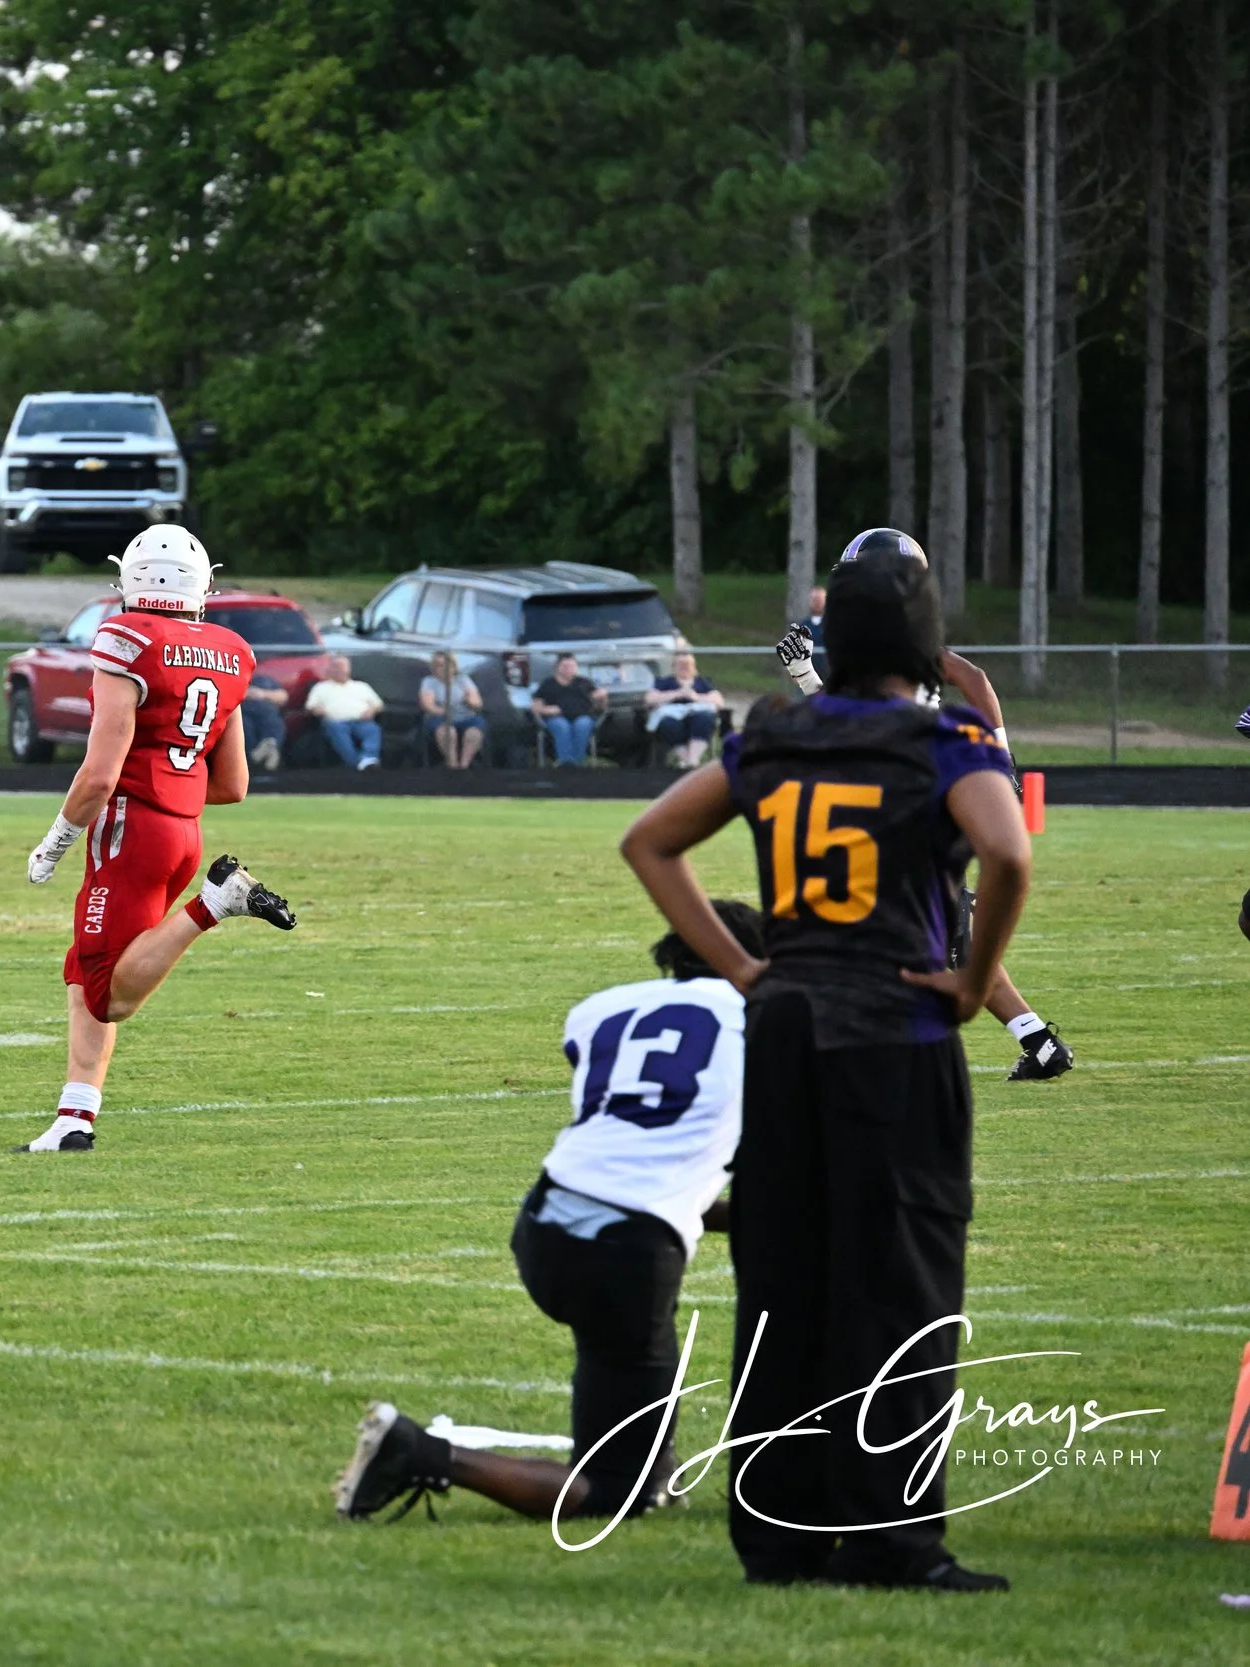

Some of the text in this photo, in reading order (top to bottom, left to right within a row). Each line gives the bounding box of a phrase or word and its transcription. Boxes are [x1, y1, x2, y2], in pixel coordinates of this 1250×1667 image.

[137, 597, 184, 610] Riddell
[163, 644, 240, 676] CARDINALS
[167, 677, 219, 772] 9
[757, 779, 884, 925] 15
[84, 886, 110, 934] CARDS
[569, 1003, 722, 1130] 13
[1035, 1038, 1058, 1067] NIKE
